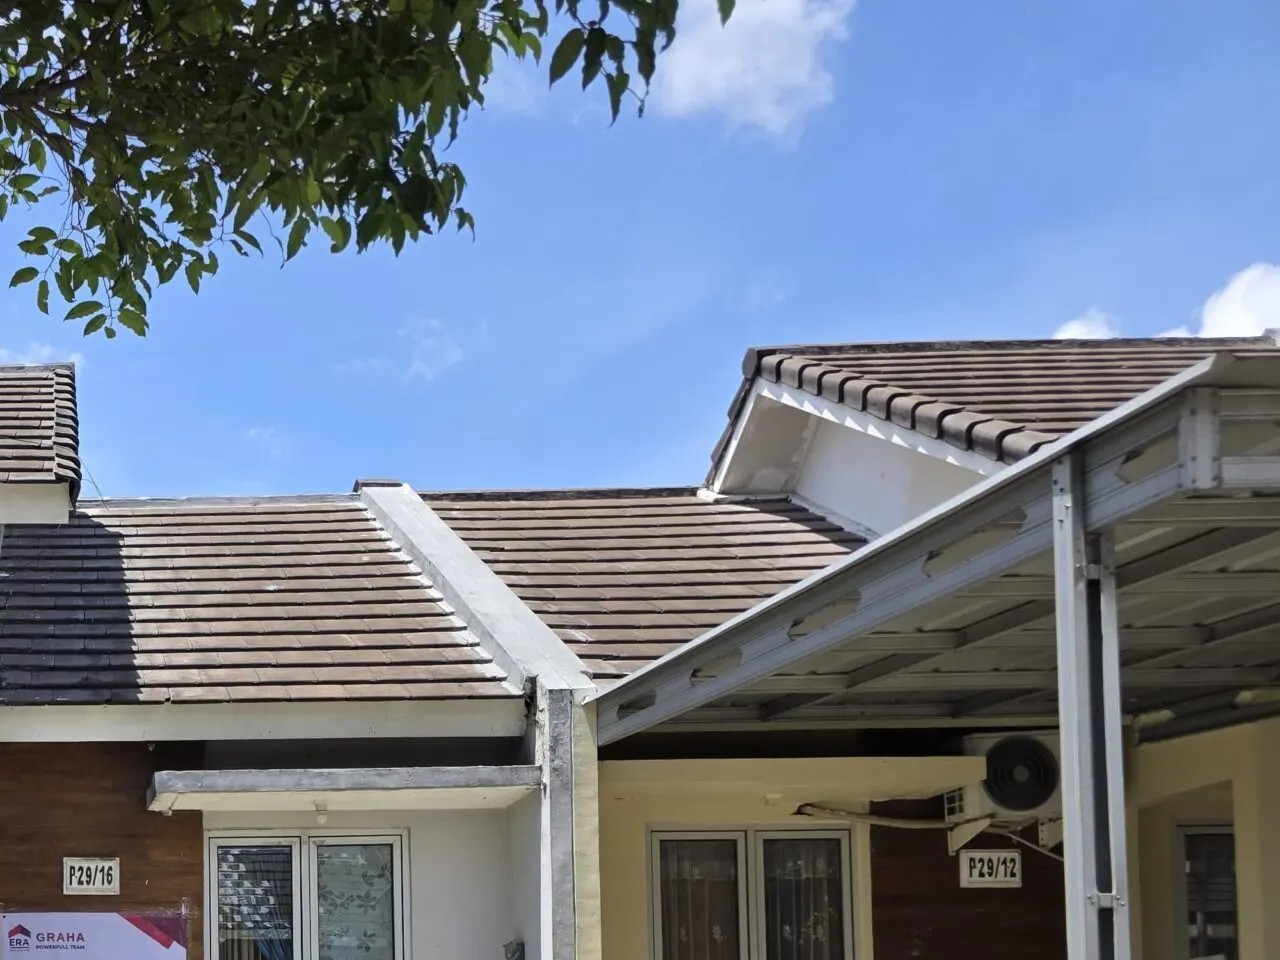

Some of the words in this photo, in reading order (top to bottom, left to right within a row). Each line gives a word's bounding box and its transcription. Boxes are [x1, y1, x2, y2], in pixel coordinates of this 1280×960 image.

[969, 857, 1017, 878] P29/12
[69, 865, 113, 886] P29/16
[9, 938, 30, 947] ERA
[36, 932, 85, 942] GRAHA
